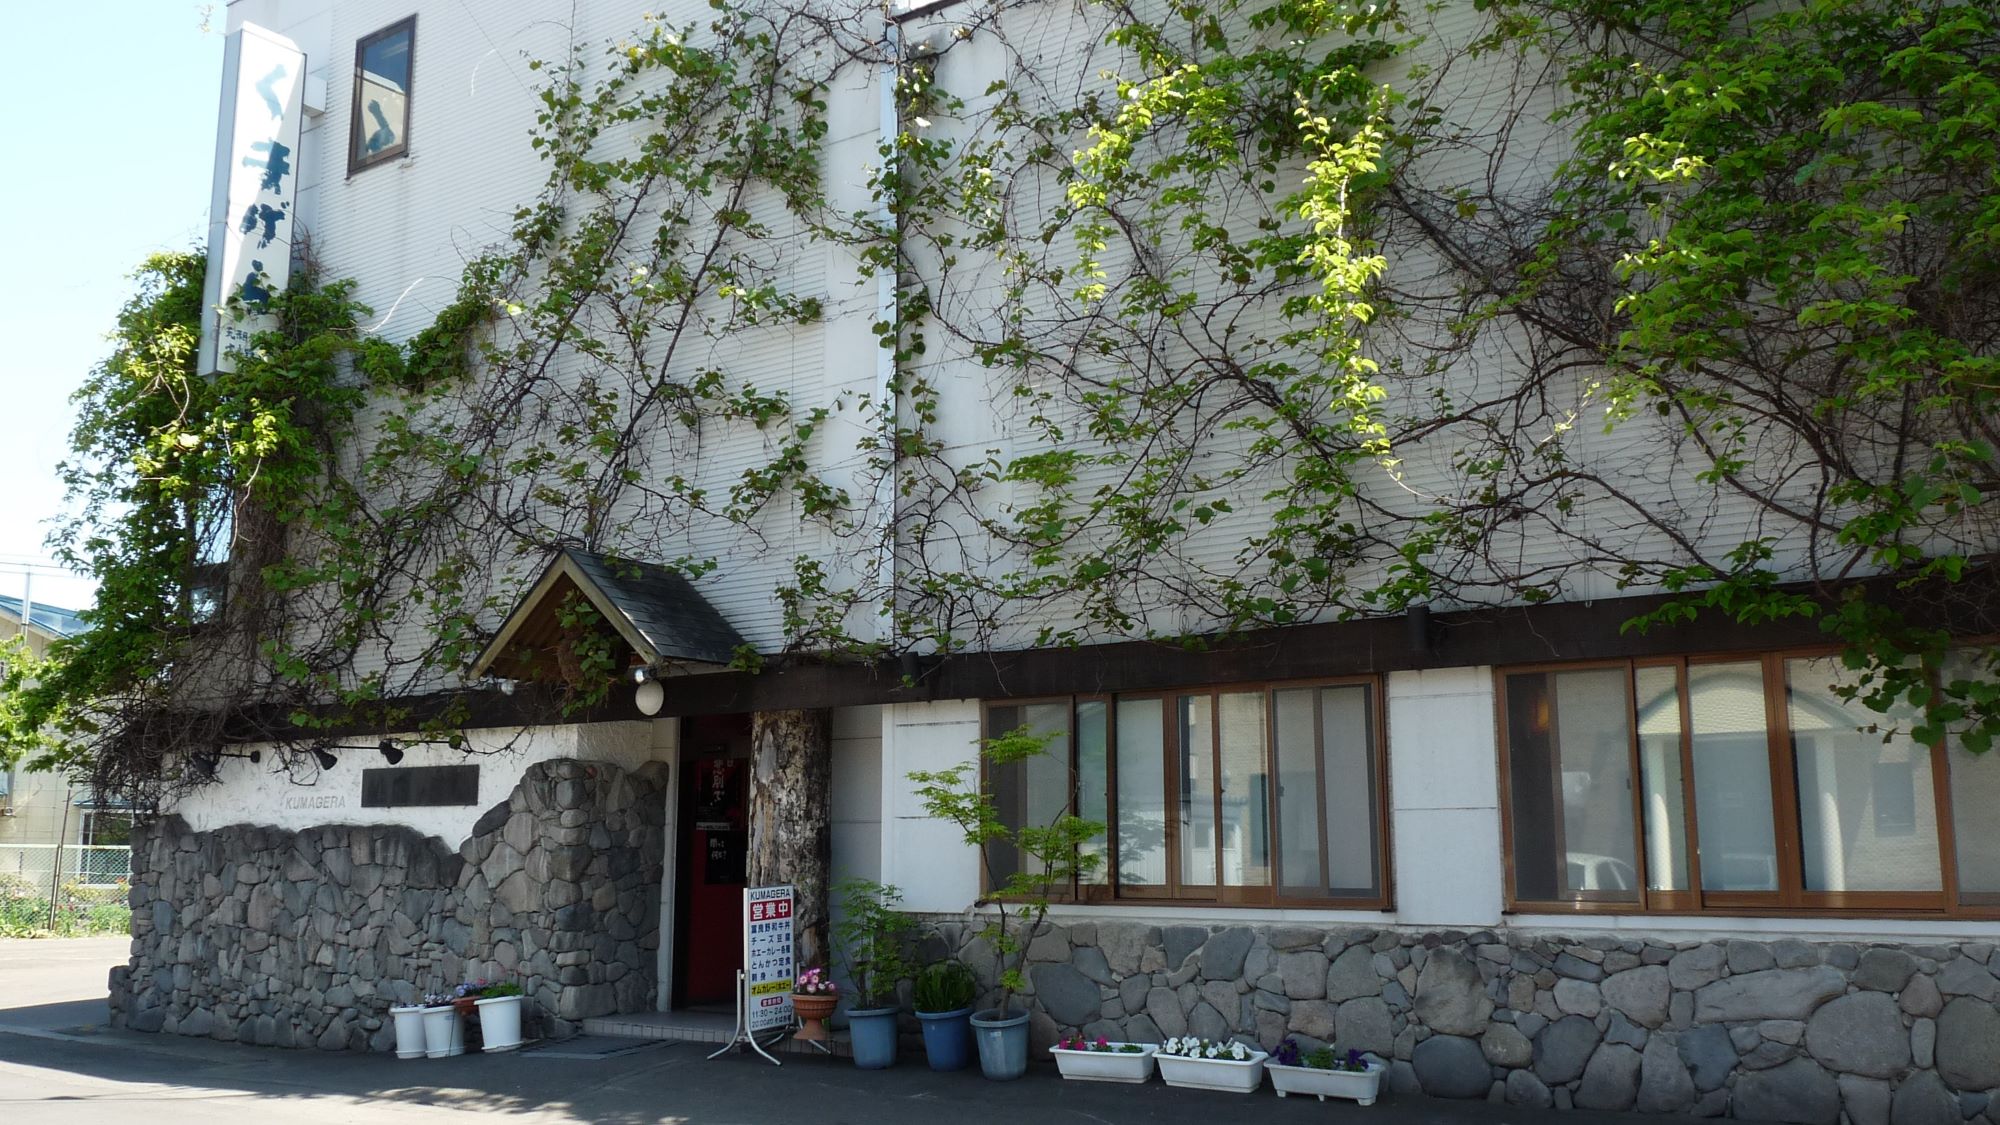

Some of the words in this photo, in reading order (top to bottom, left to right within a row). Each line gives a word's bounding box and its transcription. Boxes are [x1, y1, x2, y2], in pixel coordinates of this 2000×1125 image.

[285, 796, 345, 809] KUMAGERA
[750, 888, 790, 901] KUMAGERA
[752, 901, 789, 920] 営業中
[751, 921, 790, 934] 富良野和牛丼
[751, 932, 790, 945] チーズ豆腐
[752, 956, 791, 970] とんかつ定食
